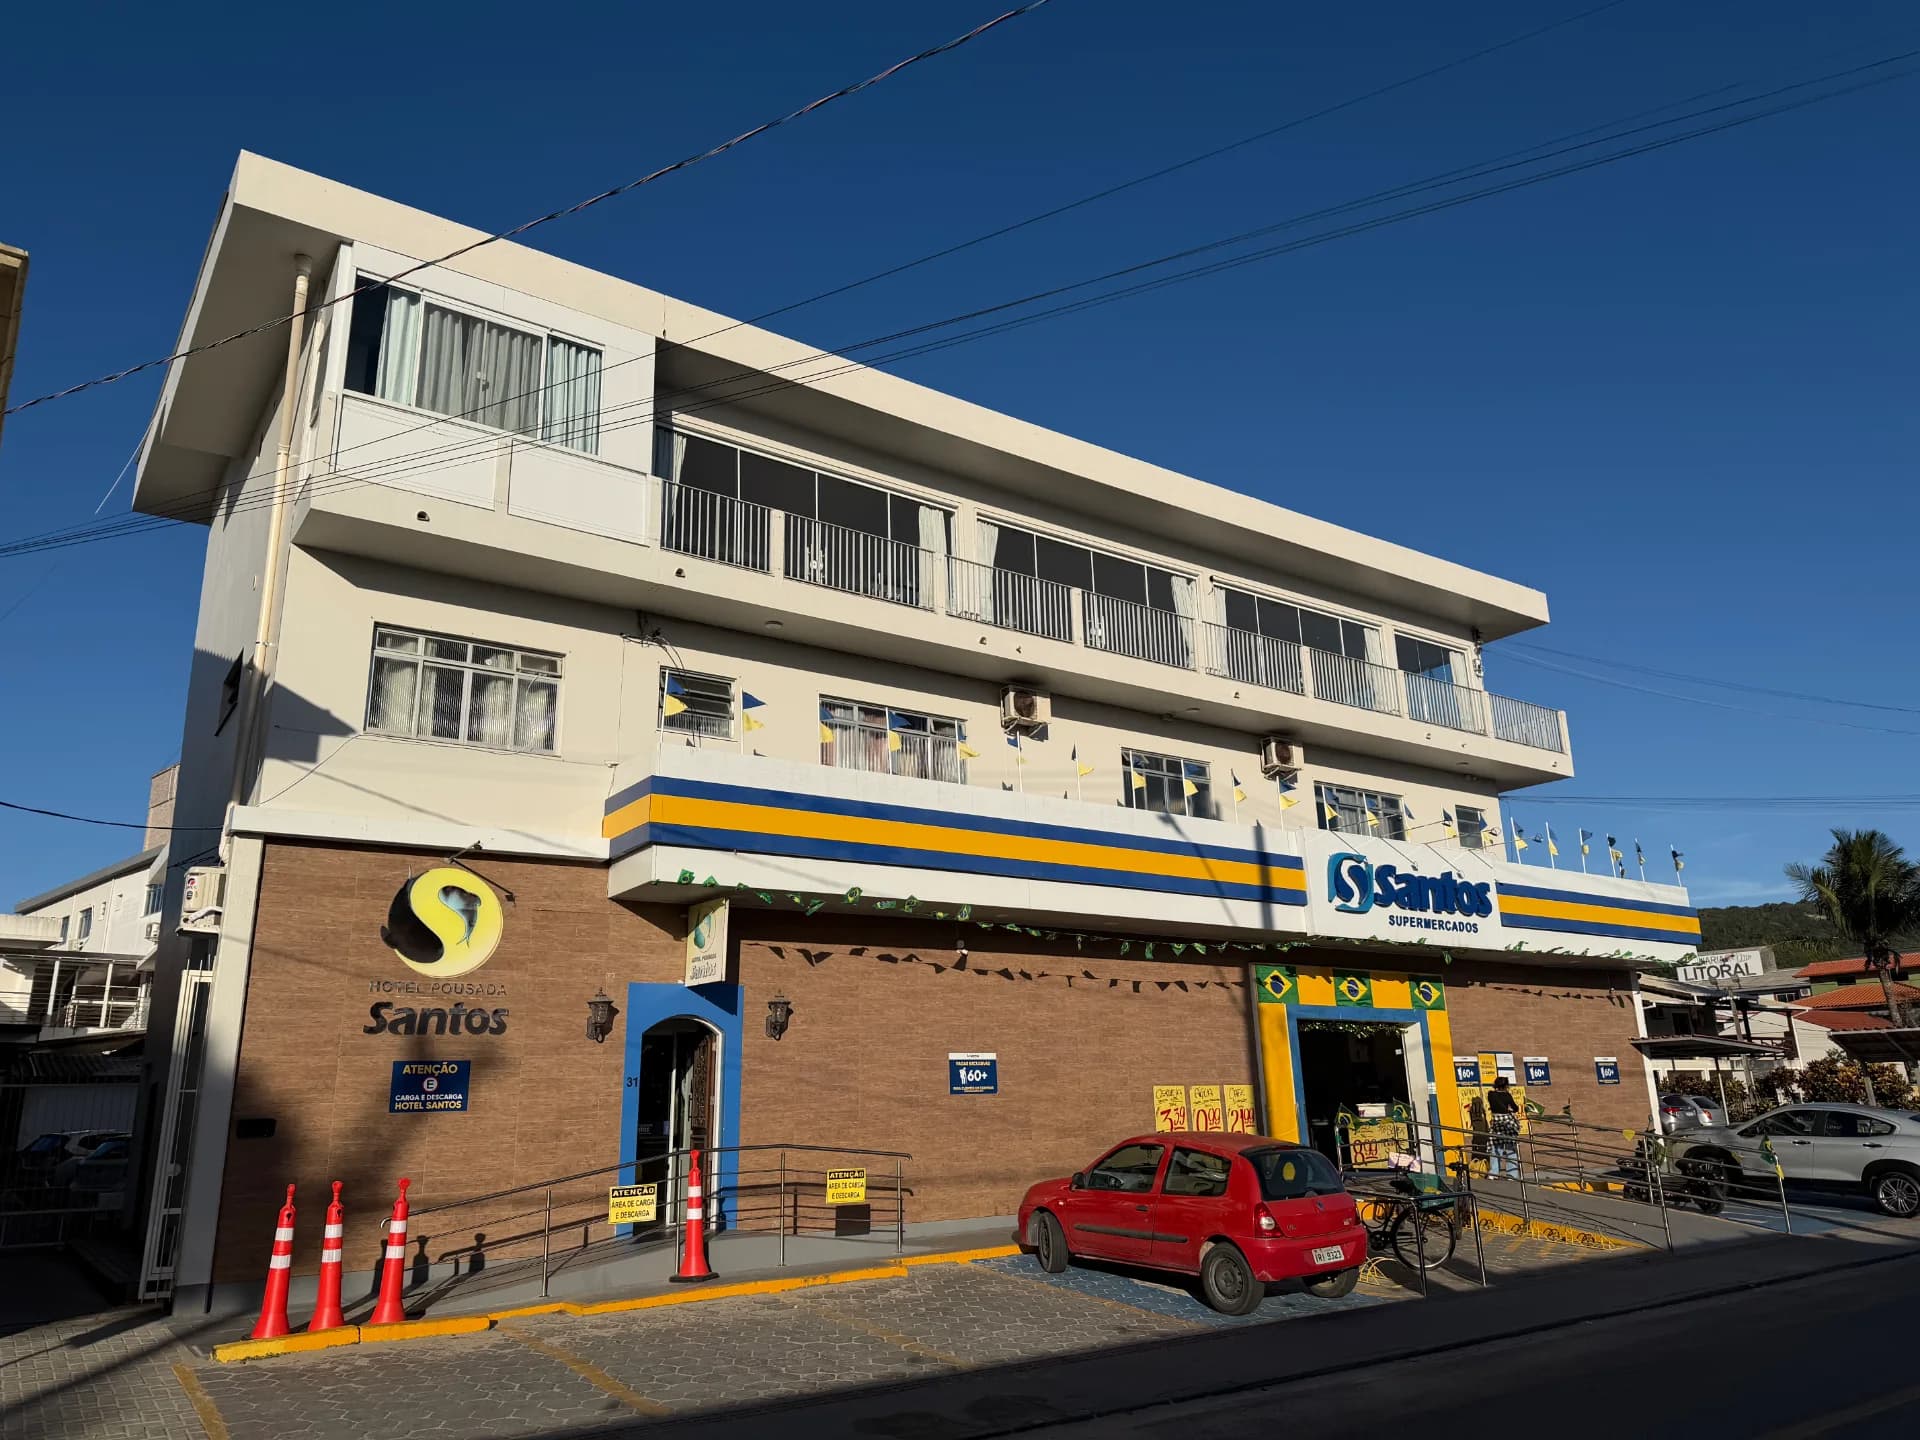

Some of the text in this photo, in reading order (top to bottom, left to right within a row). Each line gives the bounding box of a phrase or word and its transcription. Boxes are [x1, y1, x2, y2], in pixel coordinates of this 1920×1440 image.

[1374, 864, 1492, 918] Santos
[1388, 914, 1479, 934] SUPERMERCADOS
[1683, 962, 1757, 981] LITORAL
[369, 980, 508, 996] HOTEL POUSADA
[363, 1001, 509, 1036] Santos
[402, 1062, 458, 1077] ATENÇÃO
[1462, 1068, 1475, 1079] 60+
[1534, 1068, 1546, 1078] 60+
[967, 1069, 988, 1082] 60+
[626, 1077, 639, 1088] 31
[426, 1093, 463, 1101] DESCARGA
[394, 1100, 462, 1110] HOTEL SANTOS
[830, 1170, 864, 1179] ATENÇÃO
[612, 1187, 655, 1197] ATENÇÃO
[636, 1199, 655, 1207] CARGA
[620, 1209, 650, 1219] DESCARGA
